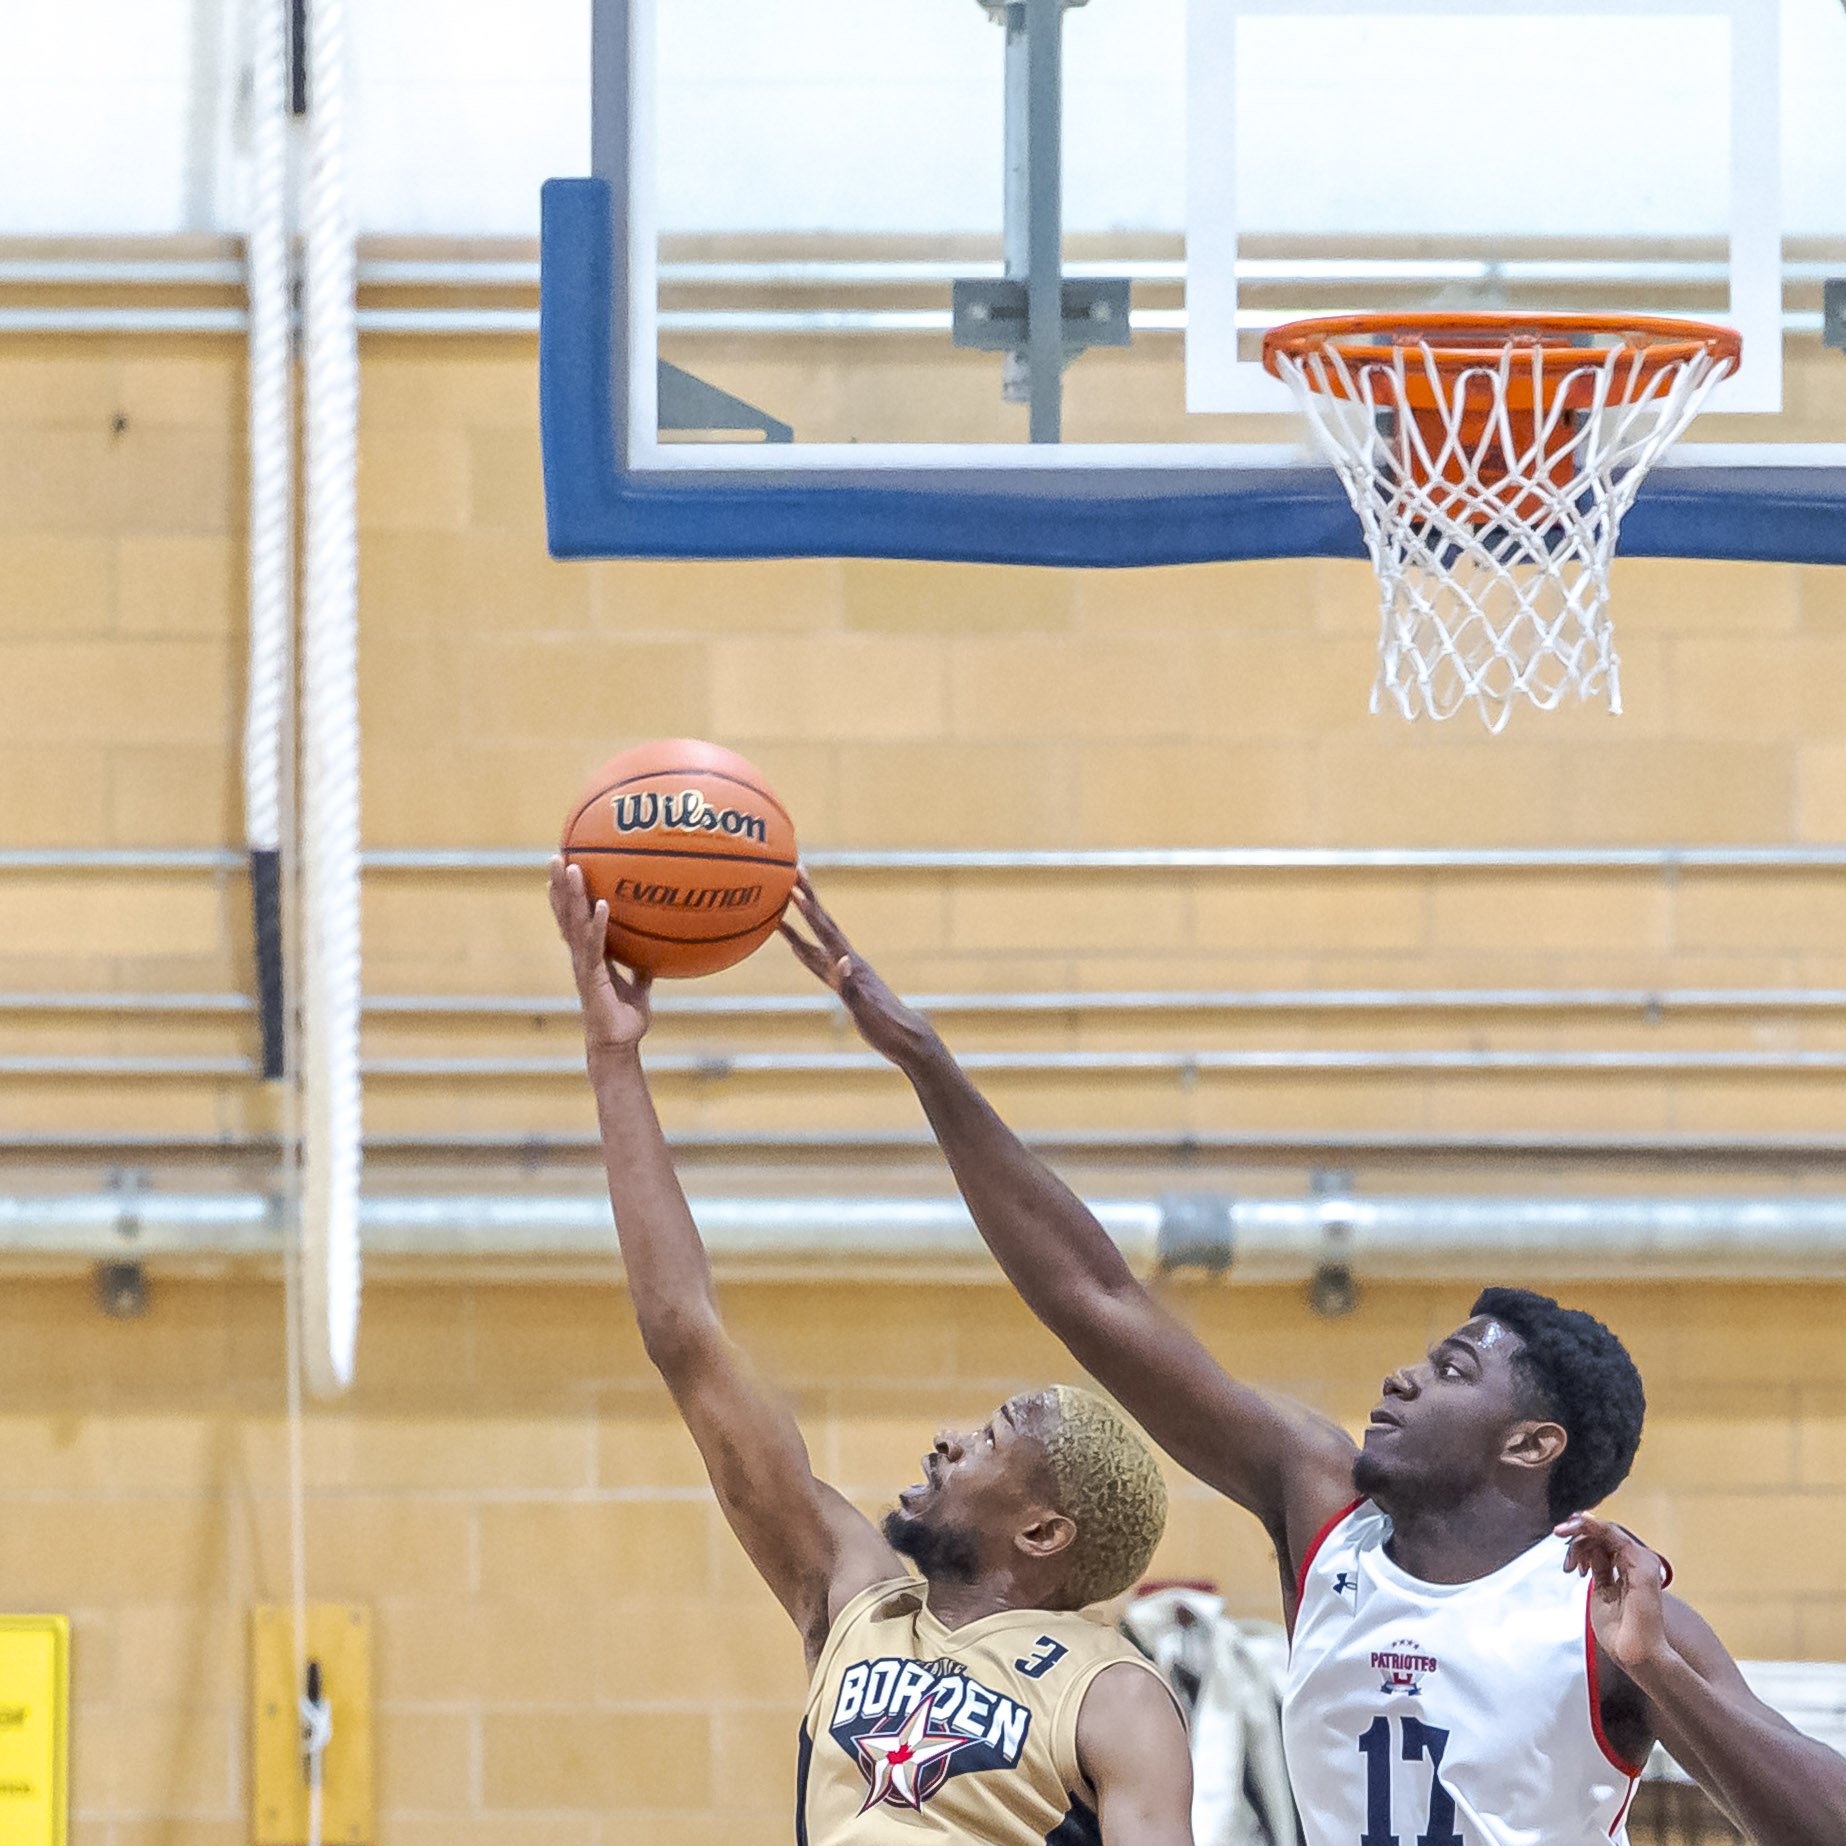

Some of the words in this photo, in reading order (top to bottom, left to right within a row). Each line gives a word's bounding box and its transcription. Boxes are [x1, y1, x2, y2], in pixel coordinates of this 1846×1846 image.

[612, 790, 769, 843] Wilson
[614, 878, 761, 908] EVOLUTION
[1014, 1635, 1069, 1679] 3
[1371, 1652, 1437, 1672] PATRIOTES
[832, 1657, 1030, 1763] BORDEN
